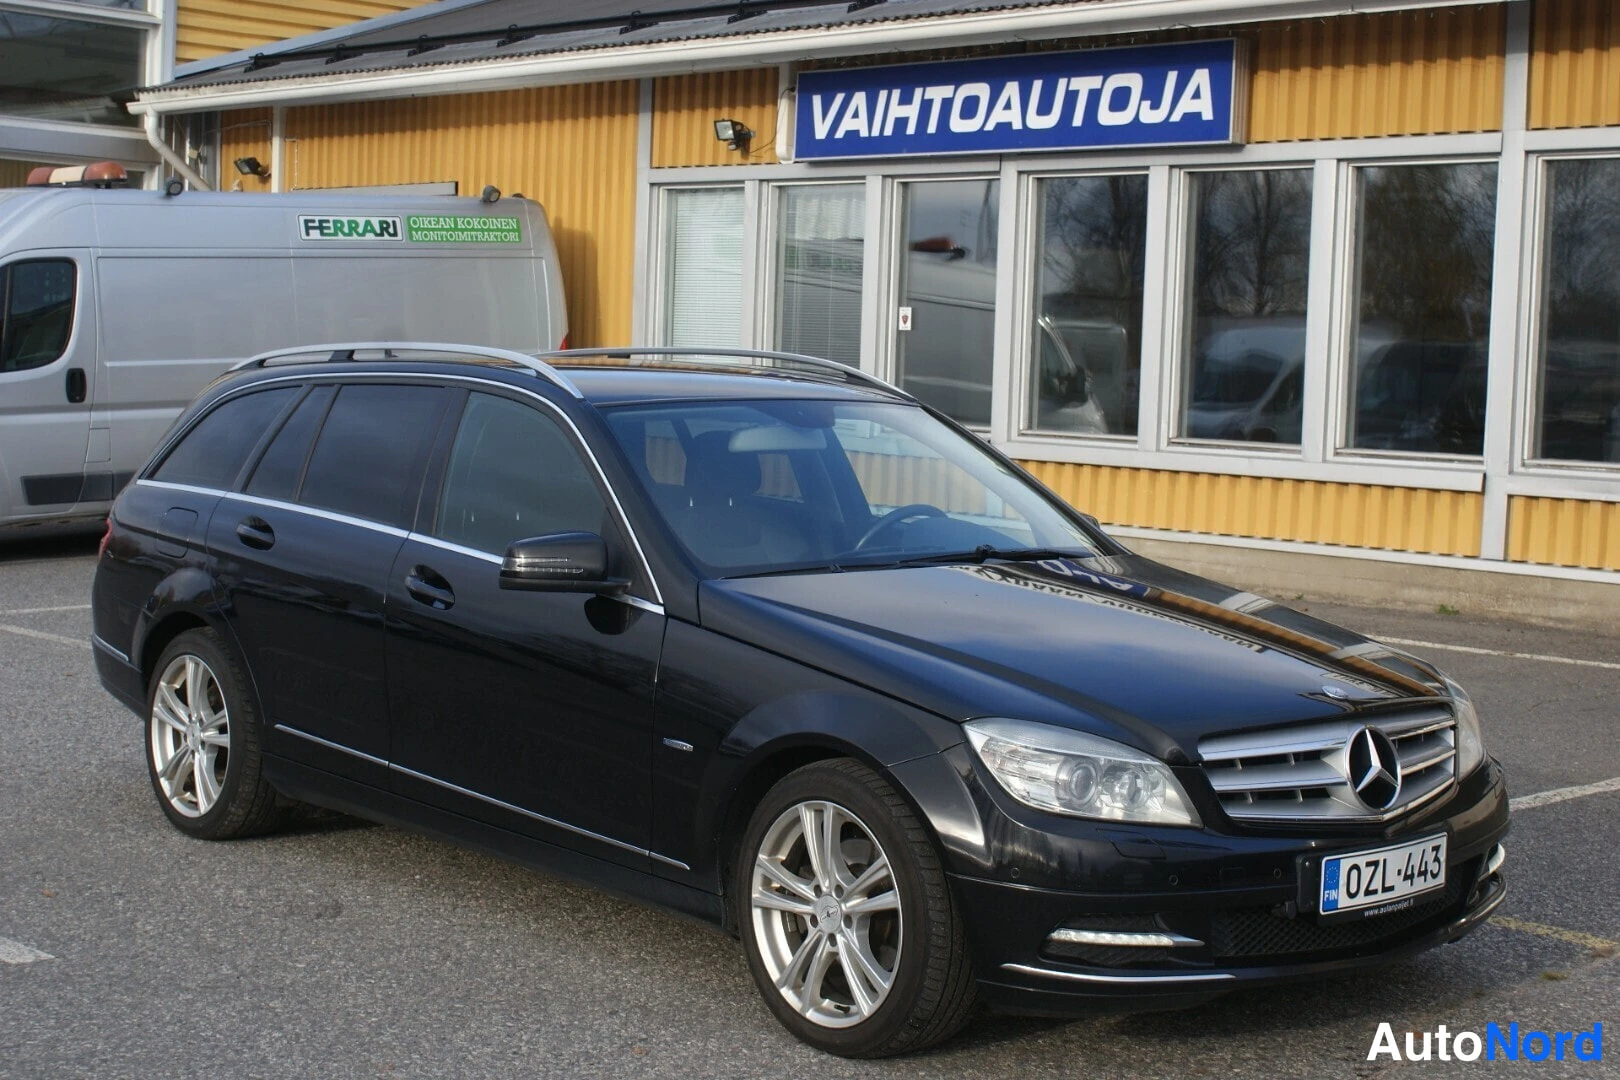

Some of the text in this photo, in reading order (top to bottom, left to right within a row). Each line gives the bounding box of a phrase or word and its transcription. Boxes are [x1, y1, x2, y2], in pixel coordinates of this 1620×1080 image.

[811, 68, 1214, 140] VAIHTOAUTOJA
[303, 218, 398, 237] FERRARI
[410, 216, 517, 229] OIKEAN KOKOINEN
[412, 230, 519, 242] MONITOIMITRAKTORI
[1345, 844, 1441, 899] OZL-443
[1324, 888, 1338, 902] FIN
